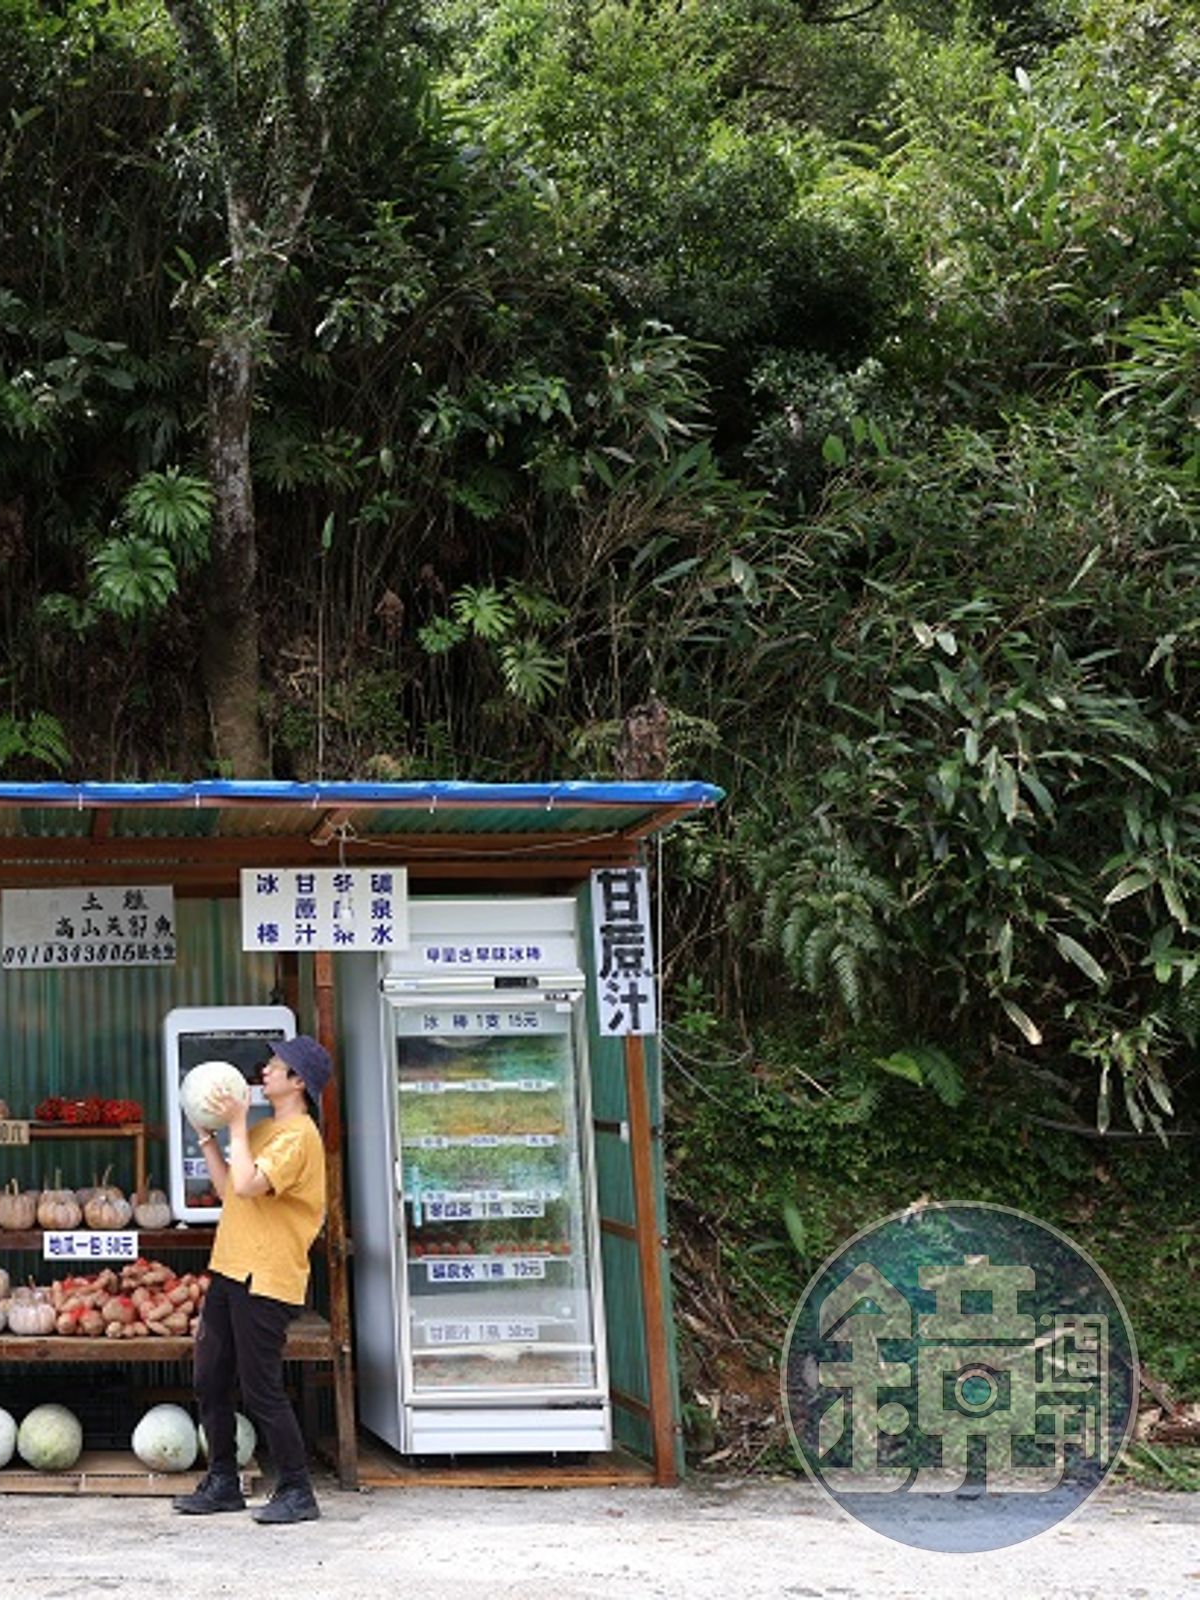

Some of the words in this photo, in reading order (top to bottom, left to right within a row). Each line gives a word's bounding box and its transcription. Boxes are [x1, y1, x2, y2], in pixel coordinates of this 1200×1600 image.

[257, 874, 279, 944] 冰棒
[295, 874, 317, 944] 甘蔗汁
[370, 874, 393, 944] 礦泉水
